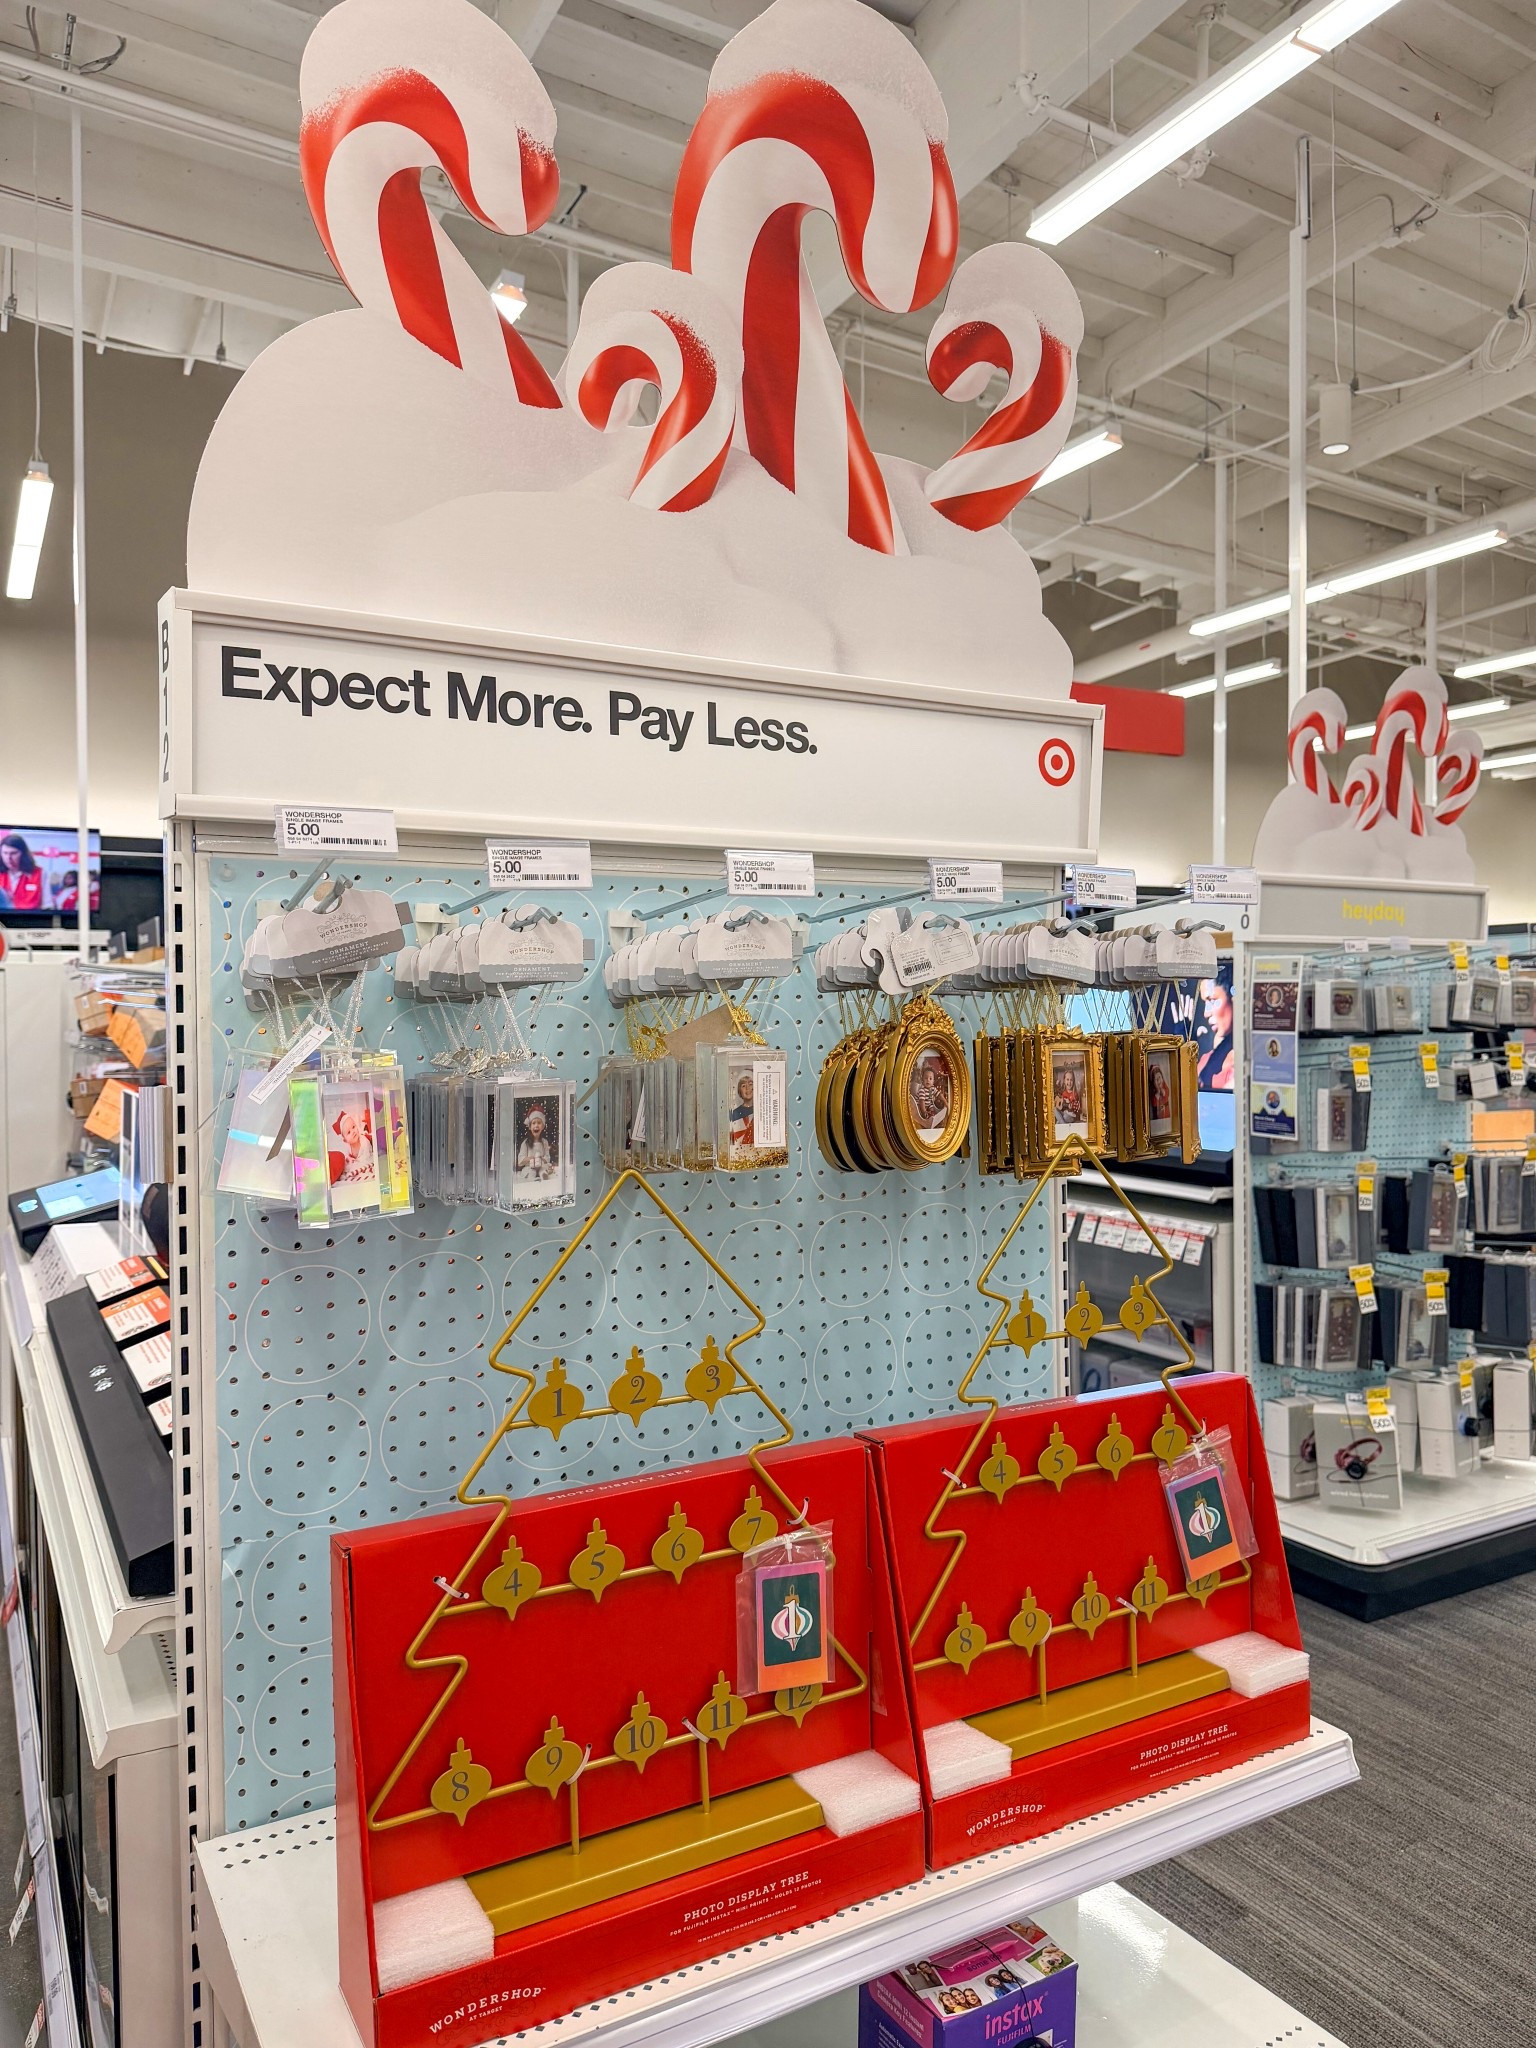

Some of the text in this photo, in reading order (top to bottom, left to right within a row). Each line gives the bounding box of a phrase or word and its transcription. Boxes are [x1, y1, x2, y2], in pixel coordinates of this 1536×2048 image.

[221, 645, 818, 755] Expect More. Pay Less.
[284, 811, 342, 819] WONDERSHOP
[287, 823, 320, 836] 5.00
[493, 861, 521, 873] 5.00
[734, 871, 758, 882] 5.00
[937, 877, 956, 887] 5.00
[1078, 882, 1095, 892] 5.00
[1197, 883, 1215, 892] 5.00
[1343, 899, 1404, 926] heyday
[319, 921, 368, 939] WONDERSHOP
[329, 941, 369, 955] ORNAMENT
[1079, 1310, 1092, 1331] 2
[1134, 1302, 1146, 1325] 3
[1023, 1314, 1035, 1338] 1
[630, 1376, 646, 1406] 2
[705, 1365, 720, 1393] 3
[552, 1388, 565, 1418] 1
[1110, 1441, 1122, 1463] 6
[1163, 1429, 1176, 1453] 7
[1053, 1449, 1064, 1473] 5
[993, 1463, 1007, 1485] 4
[546, 1488, 595, 1500] PHOTO
[600, 1477, 653, 1490] DISPLAY
[746, 1517, 761, 1547] 7
[670, 1533, 686, 1563] 6
[589, 1551, 605, 1581] 5
[504, 1568, 522, 1597] 4
[1140, 1583, 1158, 1604] 11
[782, 1600, 802, 1639] 1
[1080, 1598, 1102, 1620] 10
[1024, 1614, 1037, 1636] 9
[959, 1629, 973, 1652] 8
[708, 1700, 734, 1732] 11
[626, 1722, 655, 1751] 10
[1140, 1724, 1228, 1760] PHOTO DISPLAY TREE
[546, 1747, 563, 1776] 9
[451, 1770, 470, 1802] 8
[966, 1804, 1043, 1837] WONDERSHOP
[683, 1871, 809, 1922] PHOTO DISPLAY TREE
[683, 1919, 709, 1932] FUJIFILM
[750, 1898, 769, 1908] PRINTS
[774, 1890, 792, 1899] HOLDS
[801, 1879, 822, 1890] PHOTOS
[429, 1987, 541, 2034] WONDERSHOP
[479, 2006, 503, 2018] TARGET
[878, 1990, 893, 2010] Camera
[893, 2005, 902, 2020] Key
[903, 2006, 908, 2016] 12
[985, 1995, 1044, 2040] instax
[997, 2024, 1031, 2046] FUJIFILM
